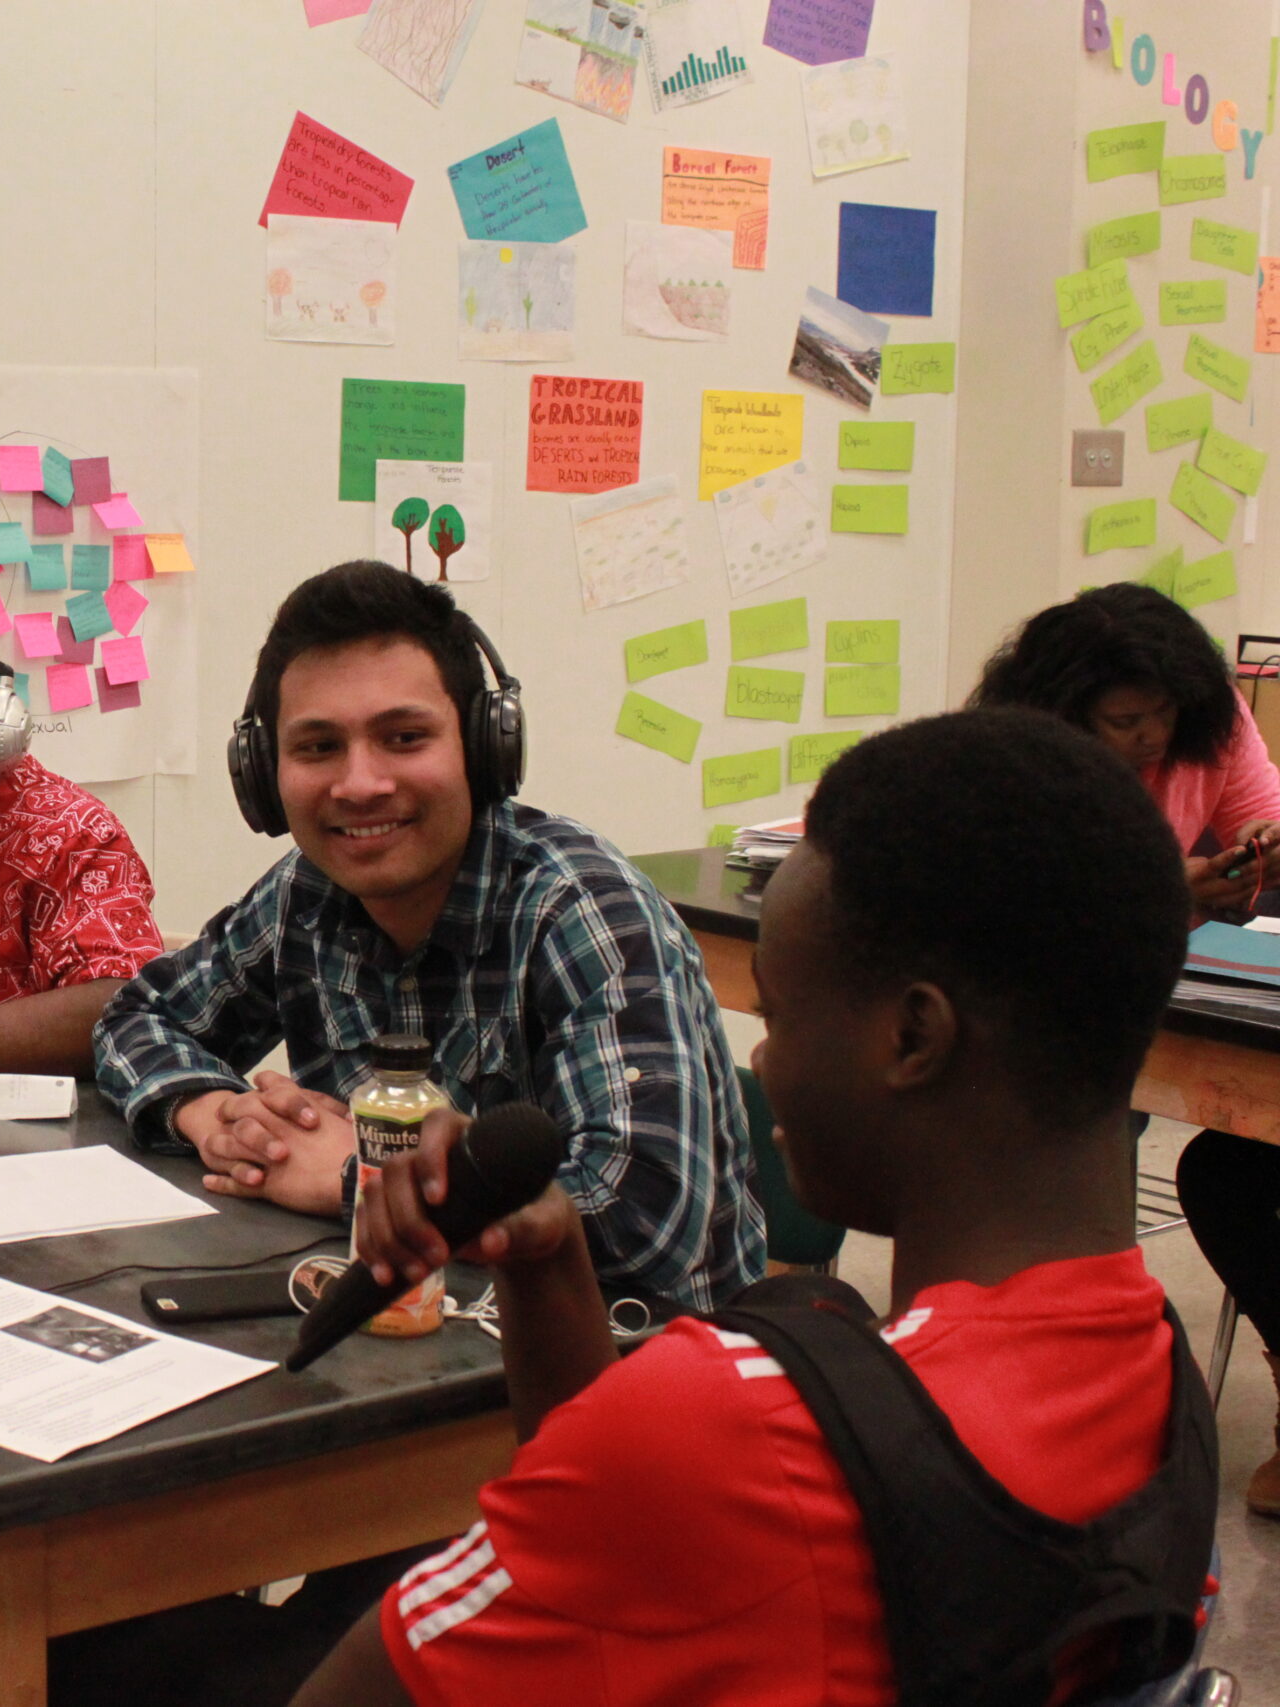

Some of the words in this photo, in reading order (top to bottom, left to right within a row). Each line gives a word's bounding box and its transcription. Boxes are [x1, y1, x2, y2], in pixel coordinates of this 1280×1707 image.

[1083, 0, 1263, 180] BIOLOGY
[298, 120, 337, 150] Tropical
[336, 143, 354, 163] dry
[485, 138, 526, 171] Desert
[282, 157, 310, 181] than
[287, 138, 309, 157] are
[311, 149, 331, 169] less
[334, 164, 344, 177] in
[672, 152, 717, 174] Boreal
[725, 159, 758, 175] Forest
[890, 350, 945, 388] Zygote
[533, 376, 642, 404] TROPICAL
[530, 402, 641, 429] GRASSLAND
[533, 446, 584, 465] DESERTS
[558, 468, 588, 484] RAIN
[592, 468, 633, 485] FORESTS
[831, 626, 882, 660] Cyclins
[30, 715, 73, 734] exual
[360, 1122, 419, 1145] Minute
[366, 1141, 414, 1162] Ma
